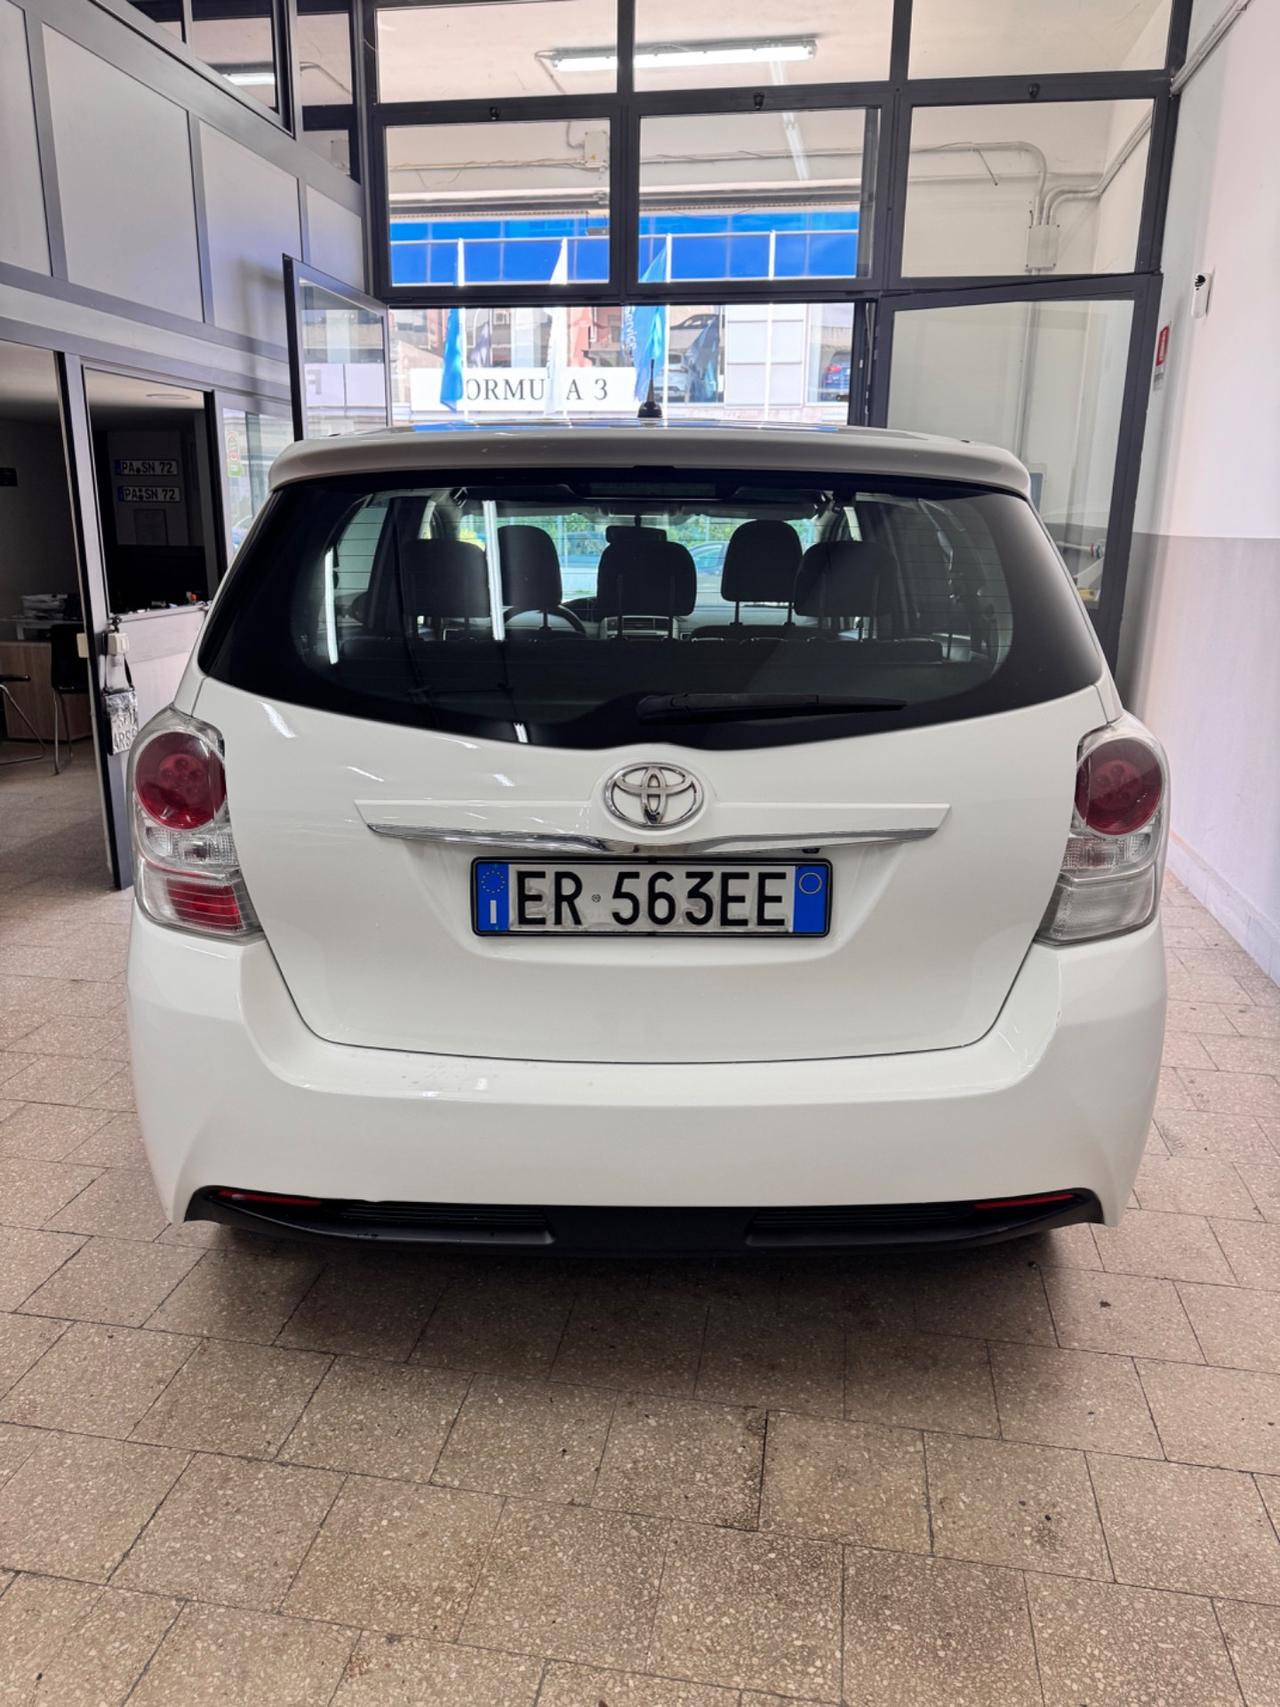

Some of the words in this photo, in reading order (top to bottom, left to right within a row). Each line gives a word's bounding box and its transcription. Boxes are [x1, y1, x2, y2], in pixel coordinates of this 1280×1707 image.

[466, 378, 583, 401] ORMUA
[594, 378, 608, 401] 3
[160, 462, 174, 474] 72
[162, 489, 176, 500] 72
[516, 870, 583, 927] ER
[611, 871, 788, 927] 563EE
